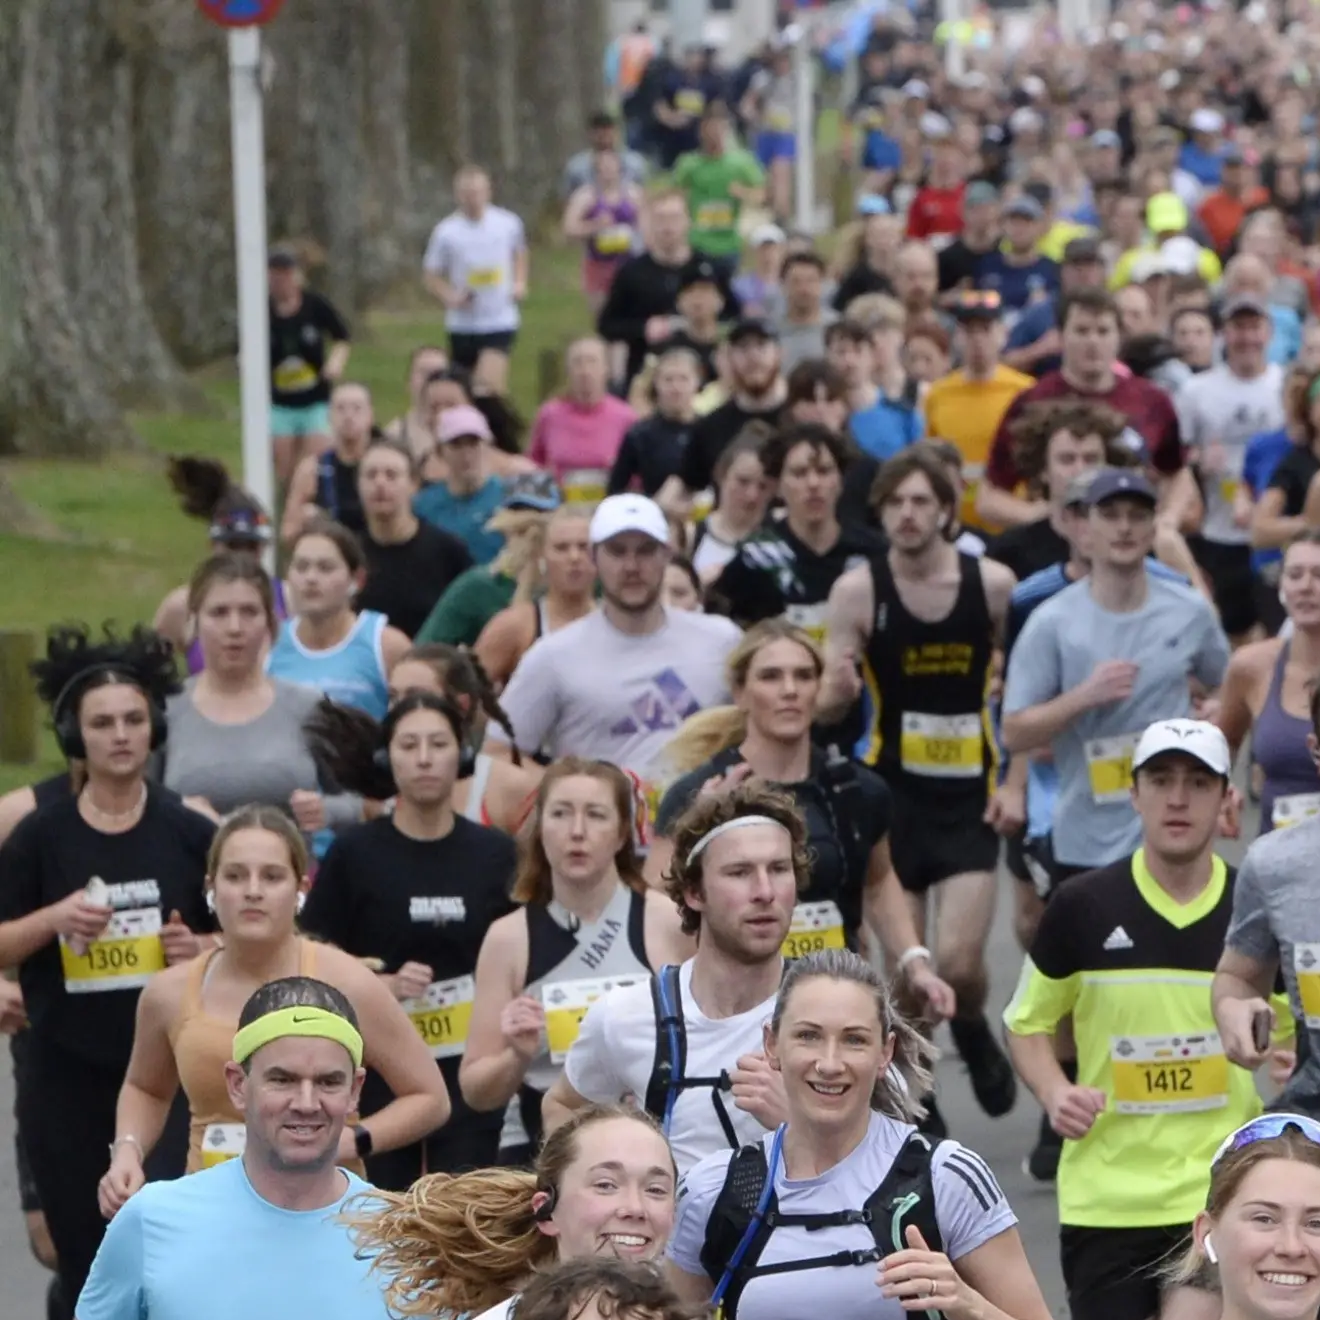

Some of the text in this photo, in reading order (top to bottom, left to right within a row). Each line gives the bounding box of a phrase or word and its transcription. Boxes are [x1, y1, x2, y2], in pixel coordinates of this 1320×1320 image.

[580, 918, 622, 970] HANA
[88, 946, 138, 970] 1306
[416, 1015, 452, 1039] 301
[1145, 1068, 1193, 1093] 1412
